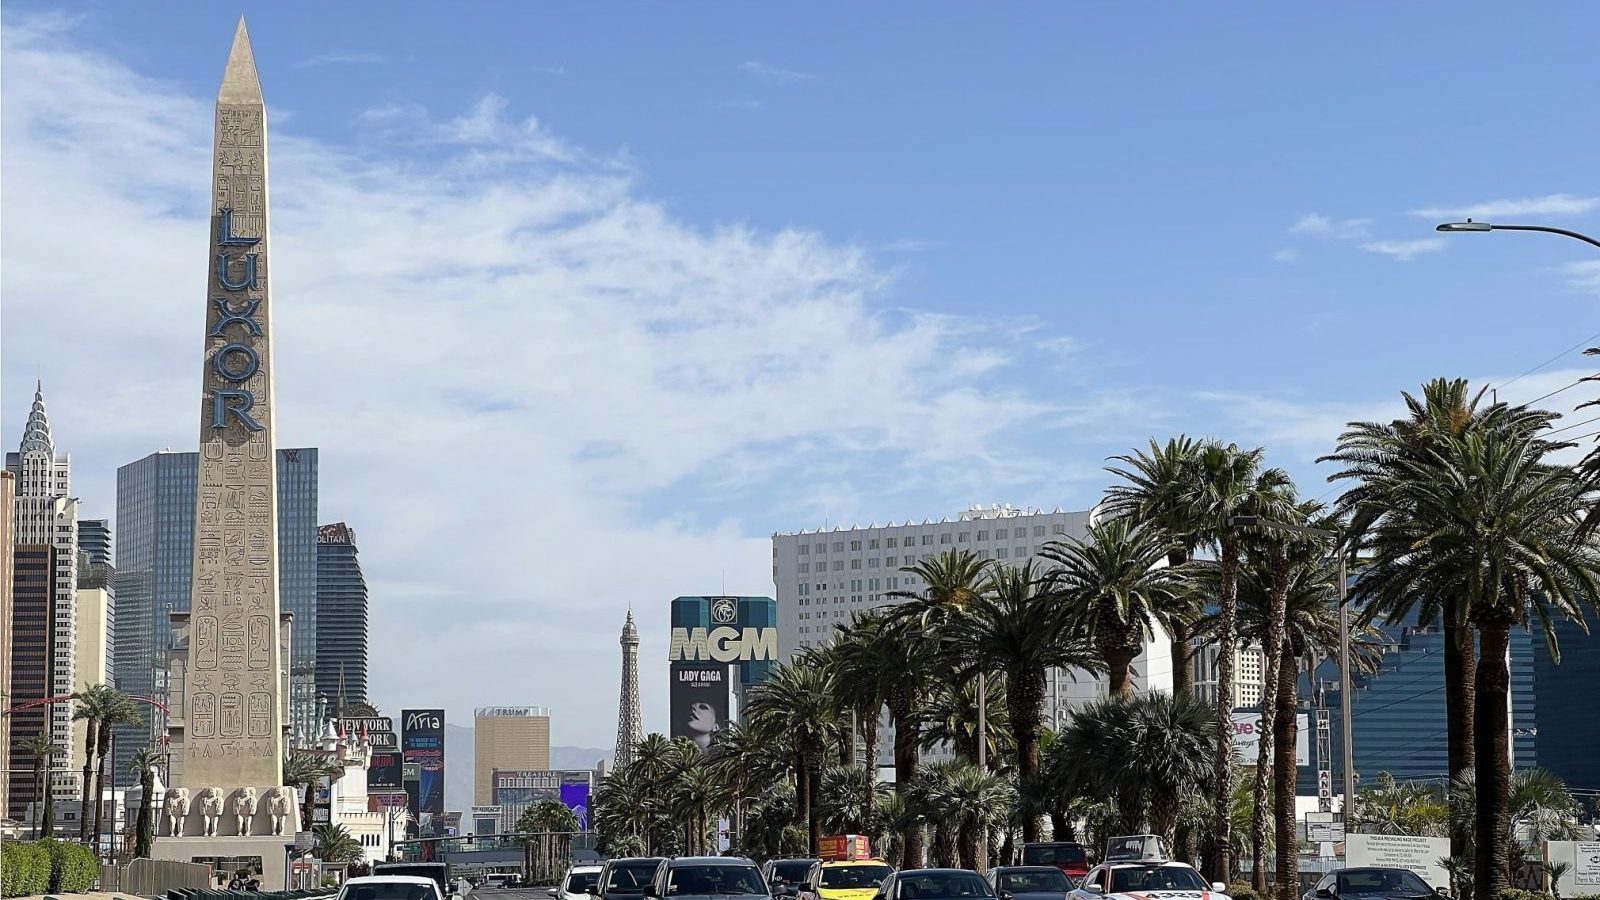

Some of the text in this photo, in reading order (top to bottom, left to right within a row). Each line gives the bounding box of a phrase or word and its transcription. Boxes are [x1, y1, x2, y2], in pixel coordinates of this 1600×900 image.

[208, 207, 265, 433] LUXOR
[317, 534, 345, 543] OLITAN
[669, 626, 778, 662] MGM
[680, 671, 721, 681] LADY GAGA
[496, 708, 529, 716] TRUMP
[363, 719, 390, 731] YORK
[406, 712, 440, 731] Aria
[368, 733, 390, 746] ORK
[1233, 738, 1254, 749] lways
[402, 768, 415, 776] GM
